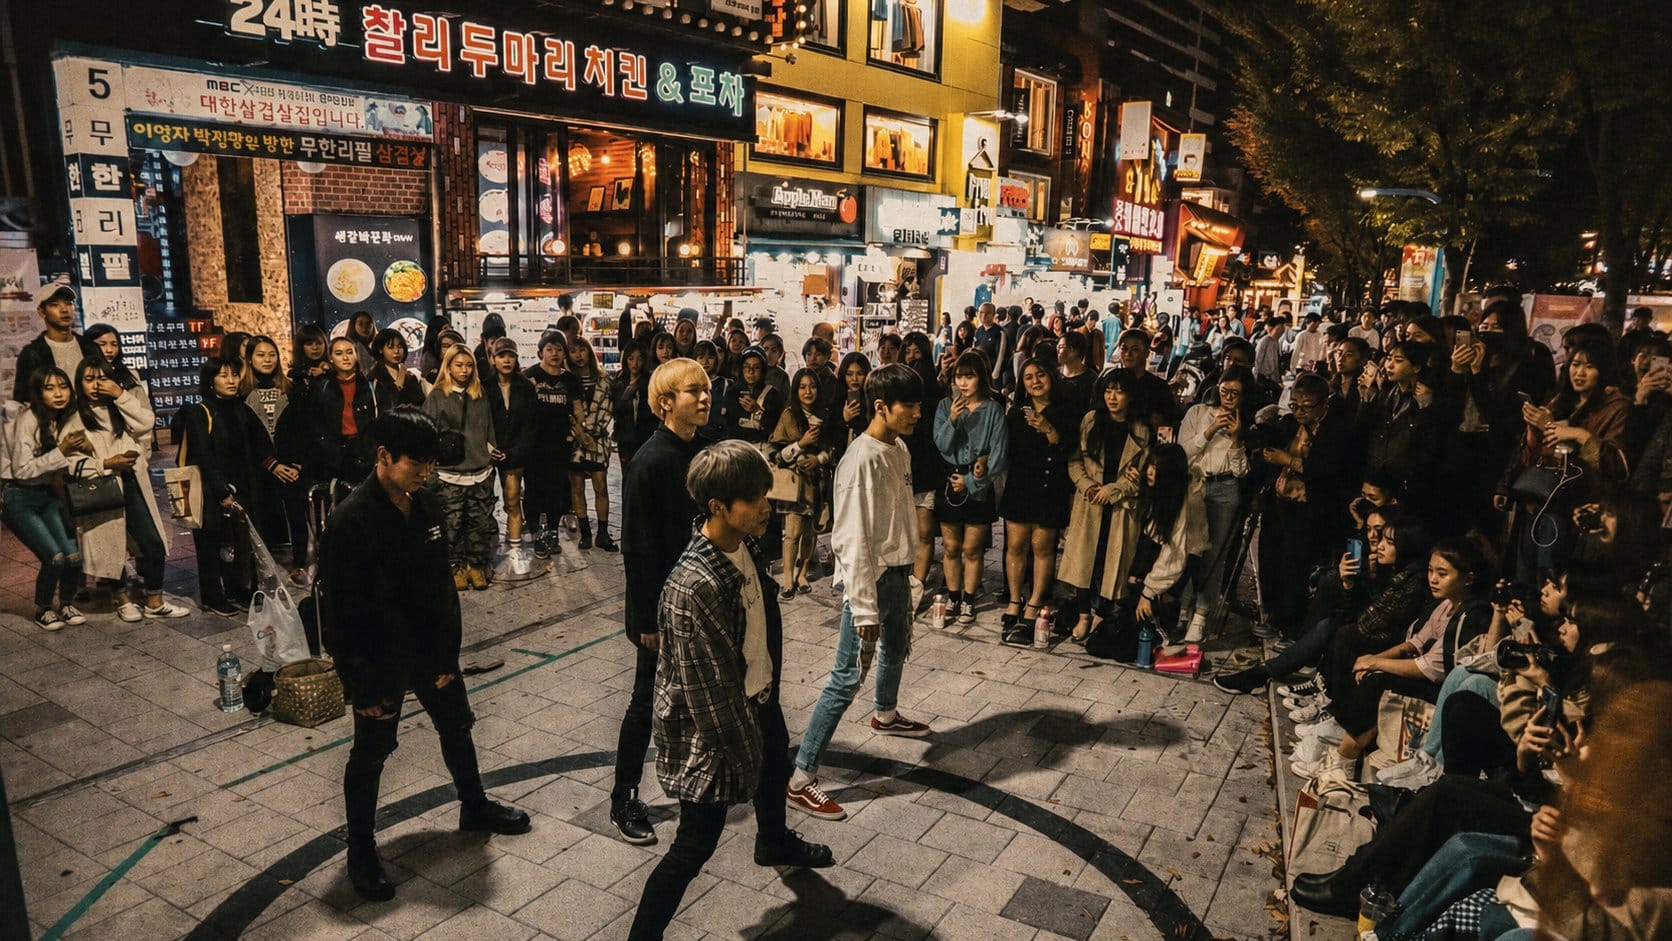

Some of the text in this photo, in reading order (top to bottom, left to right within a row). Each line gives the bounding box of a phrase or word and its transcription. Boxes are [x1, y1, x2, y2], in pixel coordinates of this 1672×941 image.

[207, 79, 241, 93] MBC
[656, 62, 684, 104] &
[689, 65, 745, 117] 포차
[300, 137, 373, 162] 무한리필
